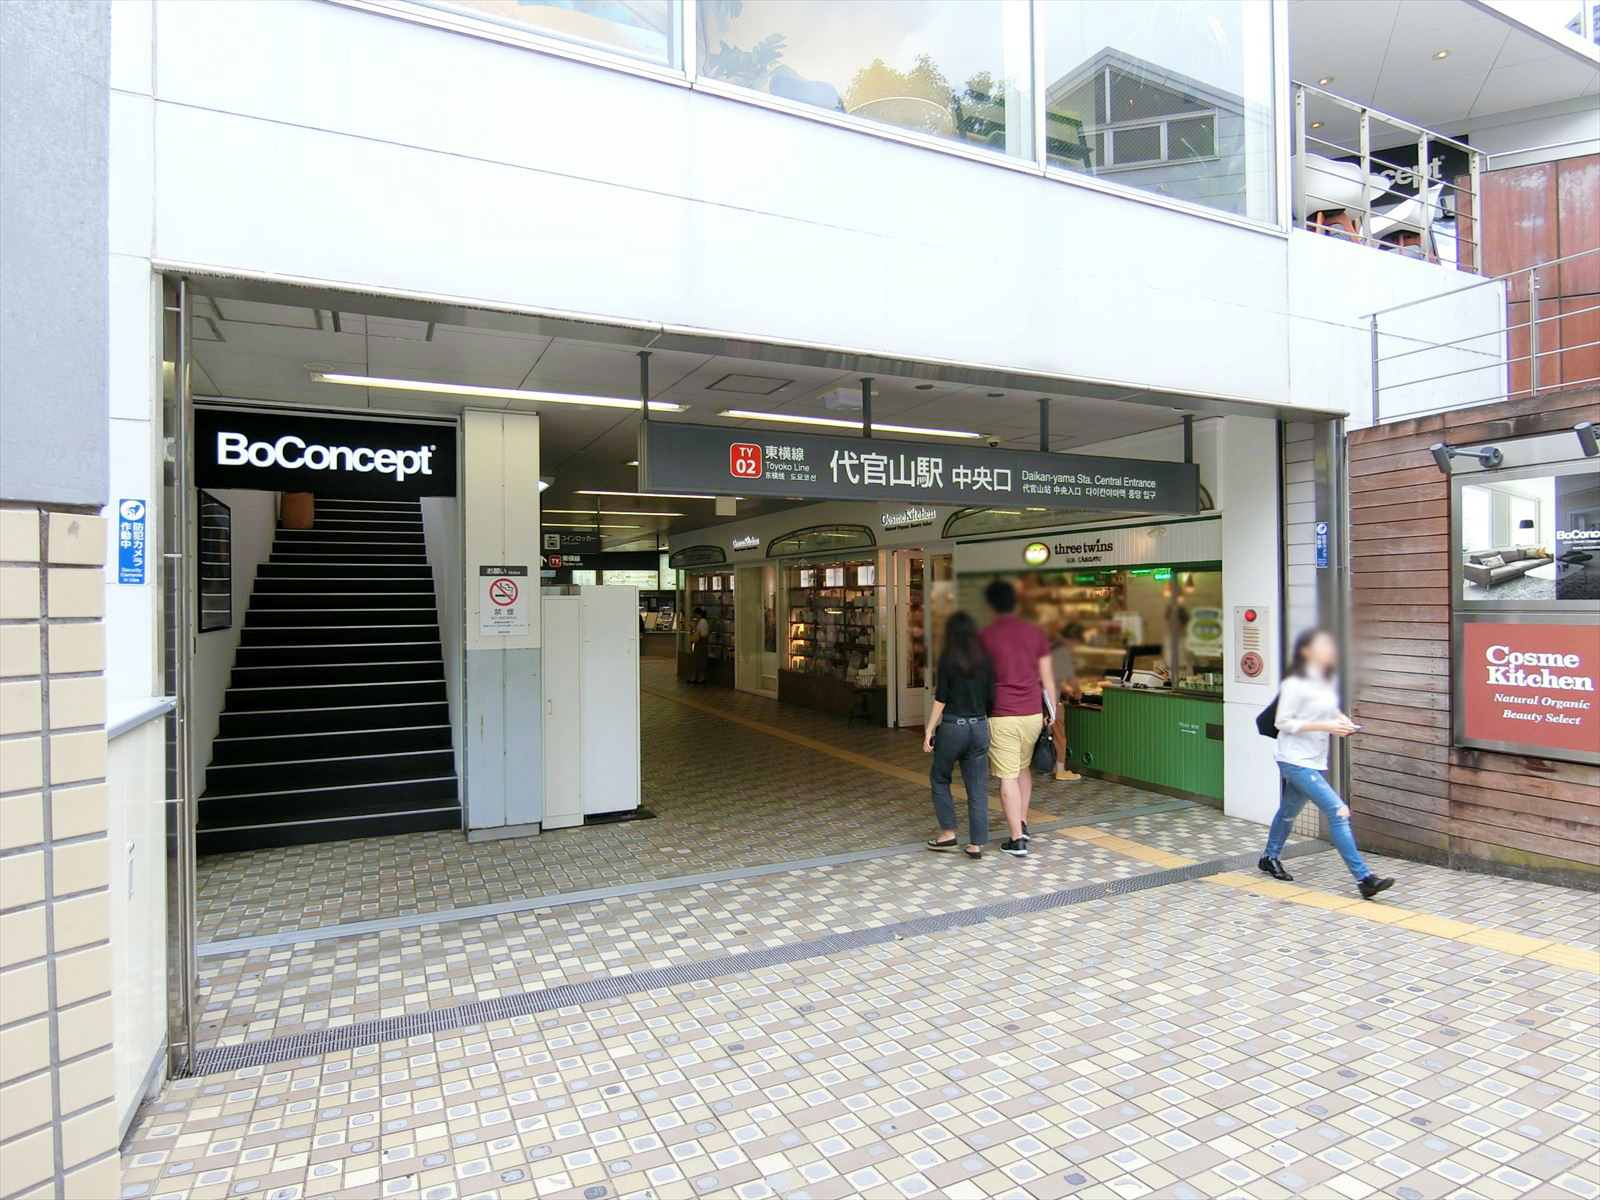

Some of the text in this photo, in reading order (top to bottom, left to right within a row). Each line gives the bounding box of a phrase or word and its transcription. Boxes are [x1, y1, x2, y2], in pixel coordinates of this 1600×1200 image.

[217, 431, 433, 482] BoConcept
[739, 447, 754, 458] TY
[765, 445, 805, 461] 東横線
[736, 459, 756, 474] 02
[765, 461, 810, 472] Toyoko Line
[829, 450, 1012, 492] 代官山駅 中央口
[1021, 470, 1156, 488] Daikan-yama Sta. Central Entrance
[121, 522, 132, 549] 作動中
[133, 522, 144, 567] 防犯カメラ
[1054, 538, 1113, 555] three twins
[1485, 645, 1580, 669] Cosme
[1486, 663, 1595, 691] Kitchen
[1494, 693, 1591, 709] Natural Organic
[1503, 709, 1581, 725] Beauty Select
